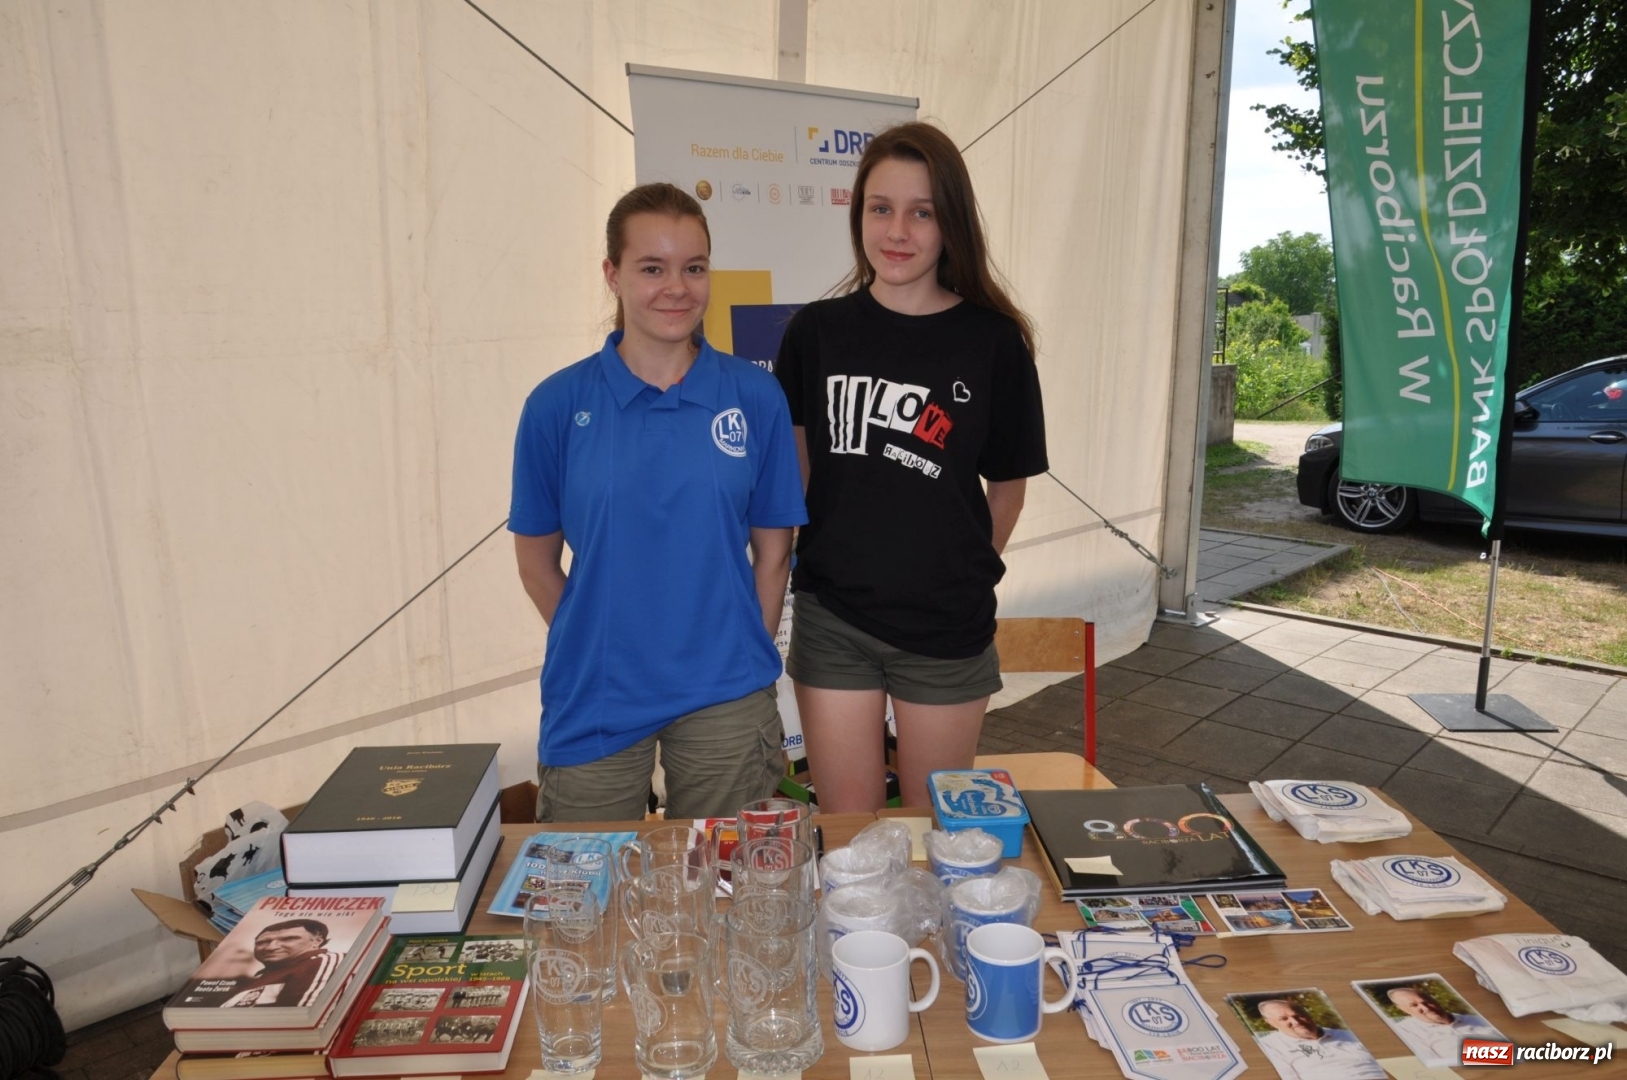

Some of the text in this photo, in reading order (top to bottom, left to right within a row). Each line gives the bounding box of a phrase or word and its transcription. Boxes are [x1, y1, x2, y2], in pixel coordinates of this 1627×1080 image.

[690, 143, 785, 163] Razem dla Ciebie
[809, 158, 838, 166] CENTRUM
[868, 379, 949, 449] LOVE
[729, 430, 742, 442] 07
[1298, 785, 1348, 799] LKS
[1197, 831, 1230, 842] LAT
[526, 861, 546, 869] 100
[1397, 861, 1444, 876] LKS
[259, 896, 385, 911] PIECHNICZEK
[1528, 950, 1563, 965] LKS
[391, 963, 467, 979] Sport
[415, 976, 462, 984] opolskiej
[1133, 1002, 1176, 1023] LKS
[1151, 1016, 1164, 1025] 07
